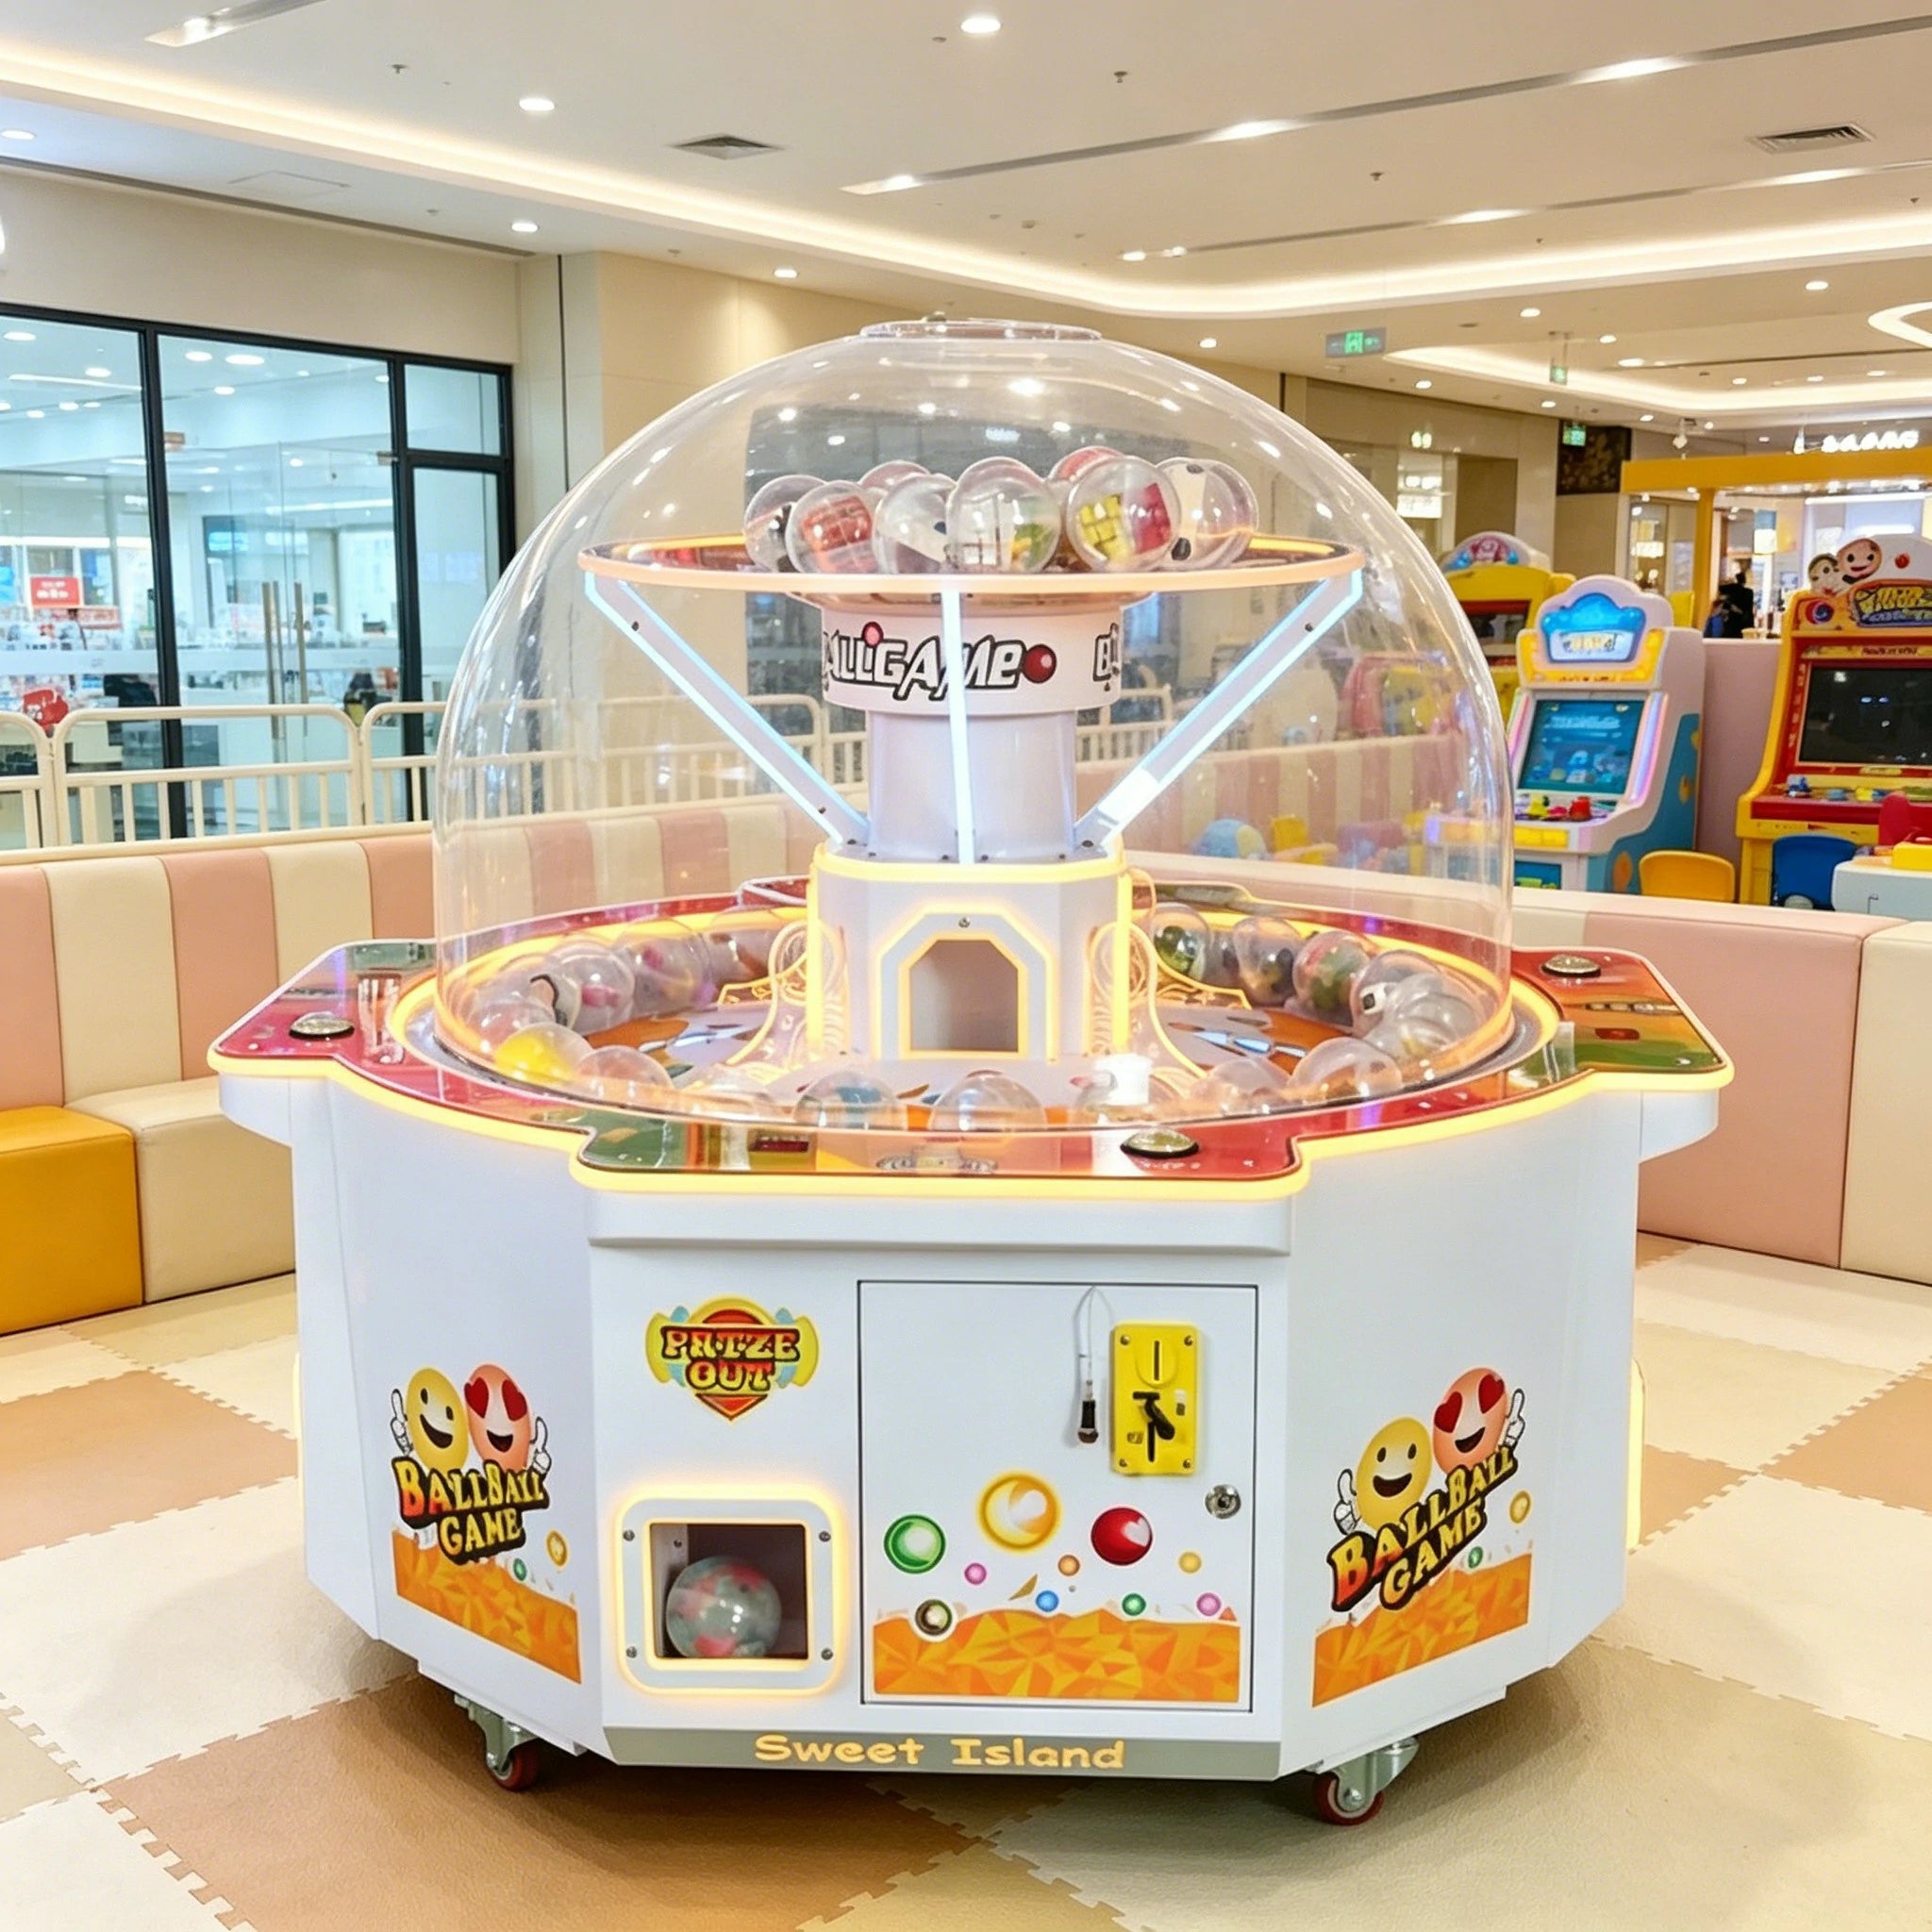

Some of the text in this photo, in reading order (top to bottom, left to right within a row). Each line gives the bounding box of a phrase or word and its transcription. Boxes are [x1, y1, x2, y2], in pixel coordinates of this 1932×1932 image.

[687, 1358, 775, 1391] OUT
[438, 1507, 525, 1562] GAME
[1380, 1498, 1488, 1608] GAME
[755, 1731, 1125, 1770] Sweet Island
